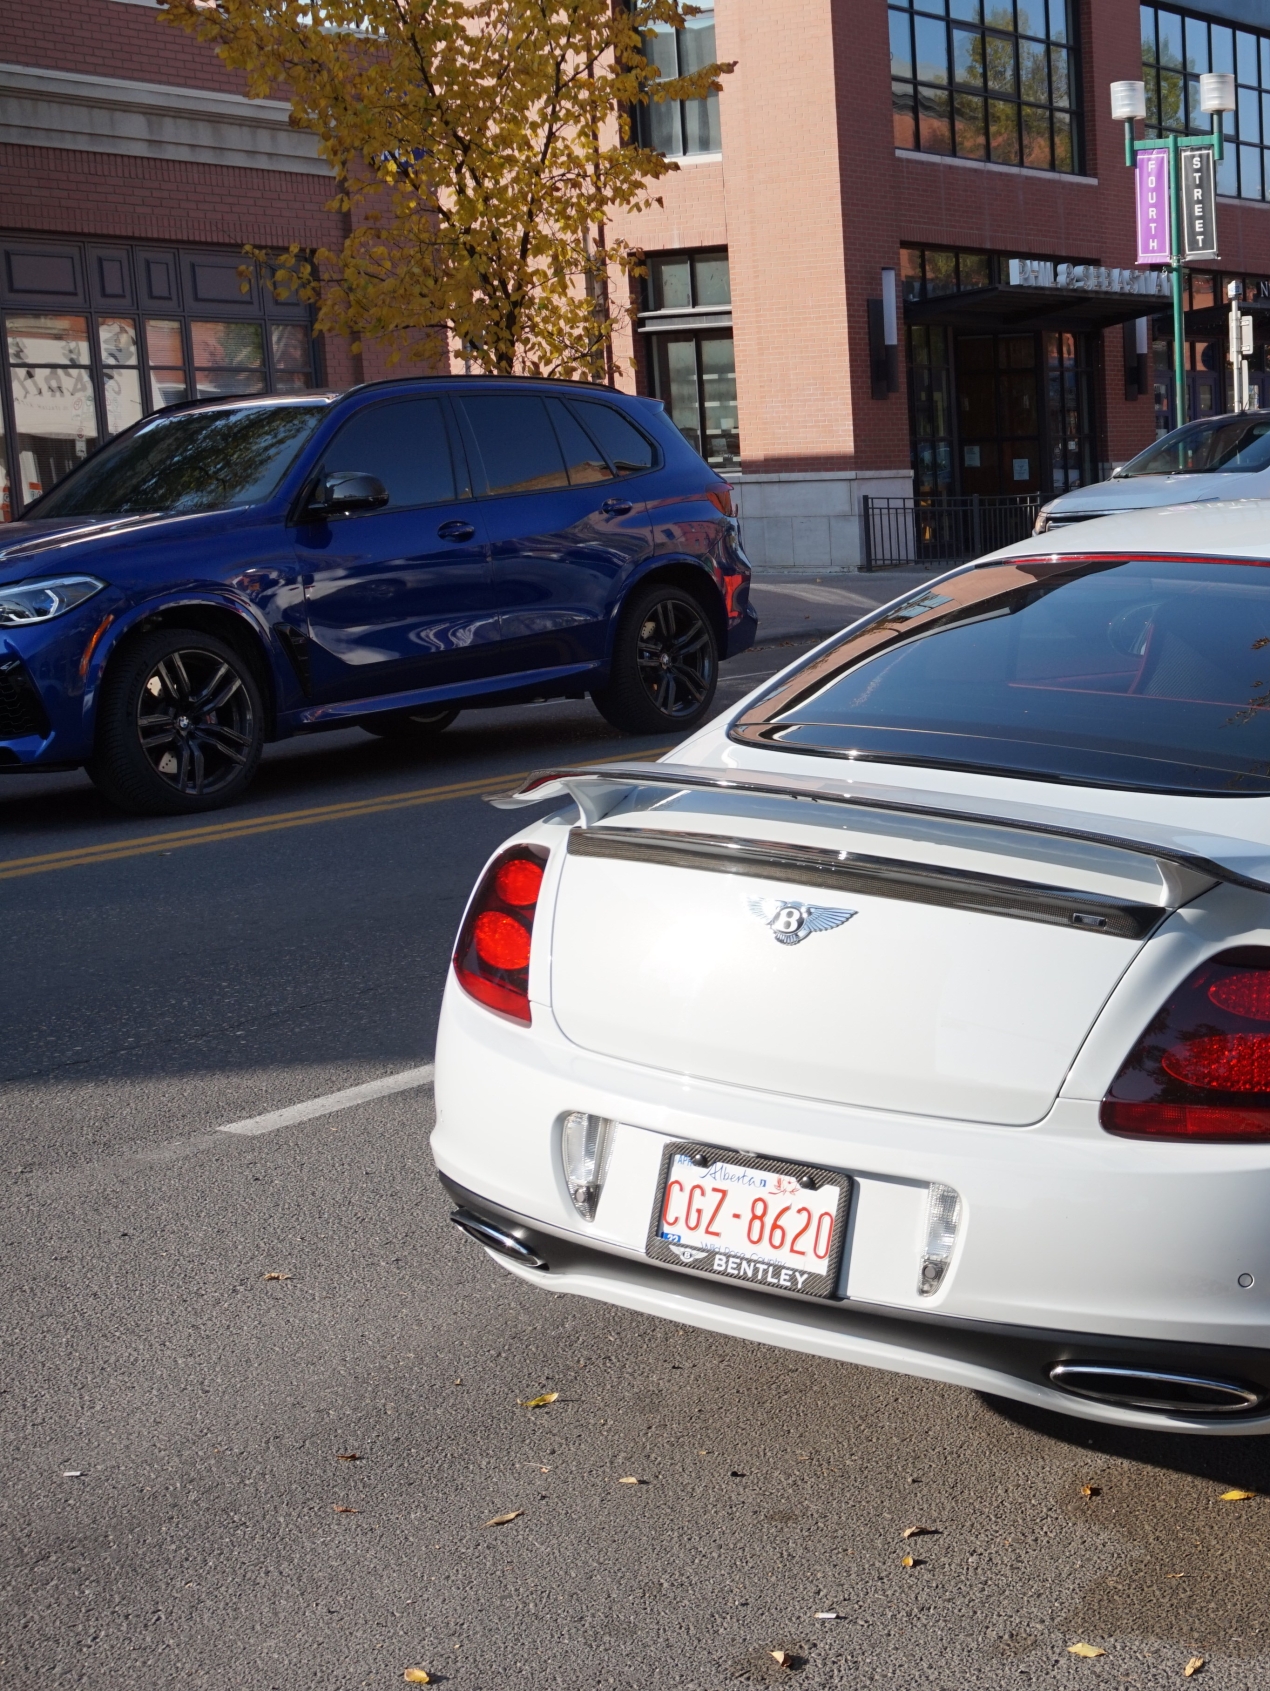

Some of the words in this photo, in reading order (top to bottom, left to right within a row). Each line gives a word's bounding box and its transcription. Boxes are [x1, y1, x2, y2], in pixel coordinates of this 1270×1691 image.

[1148, 161, 1158, 250] FOURTH
[1192, 157, 1204, 248] STREET
[1057, 262, 1076, 289] &
[699, 1160, 760, 1188] Alberta
[663, 1179, 834, 1259] CGZ-8620
[713, 1255, 808, 1288] BENTLEY
